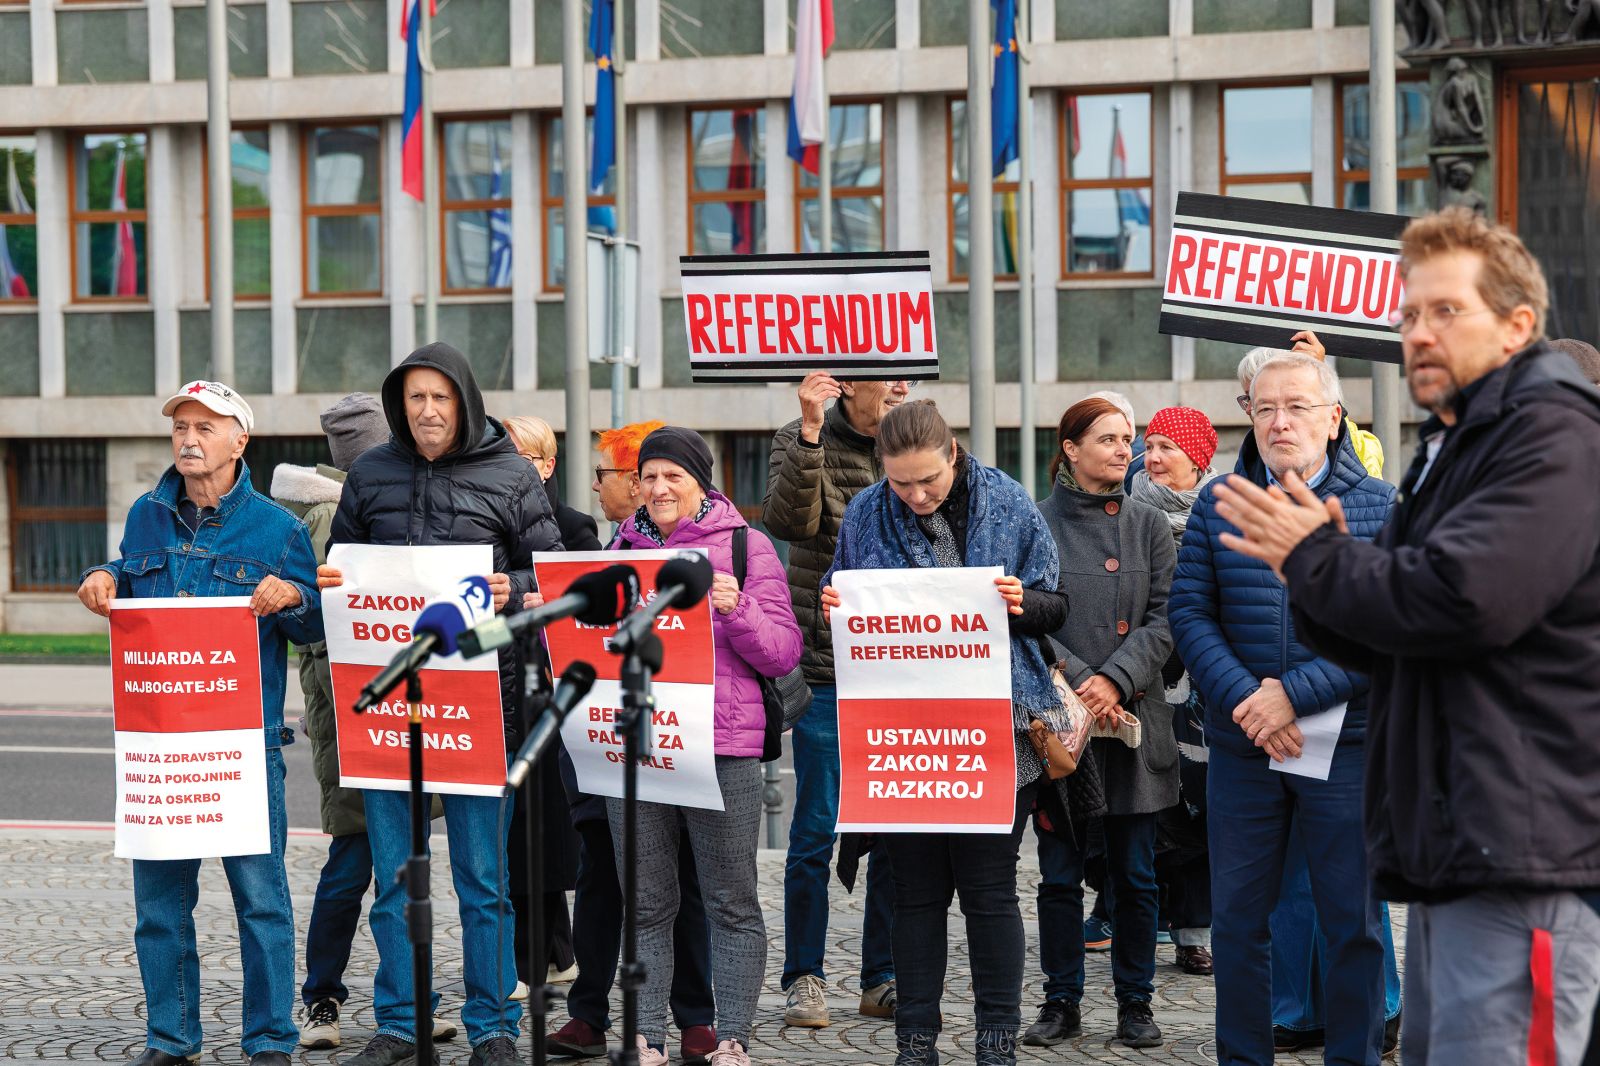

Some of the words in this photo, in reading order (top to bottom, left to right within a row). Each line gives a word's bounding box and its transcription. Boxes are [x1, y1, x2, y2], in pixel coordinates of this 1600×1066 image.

[687, 291, 934, 355] REFERENDUM
[347, 594, 425, 612] ZAKON
[657, 615, 685, 630] ZA
[847, 615, 942, 634] GREMO
[951, 614, 989, 632] NA
[352, 622, 413, 643] BOG
[124, 651, 204, 665] MILIJARDA
[210, 651, 236, 664] ZA
[851, 644, 991, 660] REFERENDUM
[125, 678, 238, 693] NAJBOGATEJŠE
[442, 705, 471, 720] ZA
[368, 729, 411, 748] VSE
[422, 732, 473, 751] NAS
[658, 734, 684, 750] ZA
[867, 729, 987, 746] USTAVIMO
[125, 752, 147, 763] MANJ
[148, 753, 161, 763] ZA
[163, 751, 242, 763] ZDRAVSTVO
[867, 754, 949, 772] ZAKON
[955, 754, 988, 772] ZA
[125, 772, 147, 783] MANJ
[148, 774, 162, 784] ZA
[165, 771, 242, 783] POKOJNINE
[867, 781, 984, 799] RAZKROJ
[125, 793, 147, 804] MANJ
[148, 794, 163, 805] ZA
[165, 793, 221, 804] OSKRBO
[124, 814, 146, 825] MANJ
[148, 815, 164, 826] ZA
[166, 814, 193, 825] VSE
[196, 813, 224, 824] NAS
